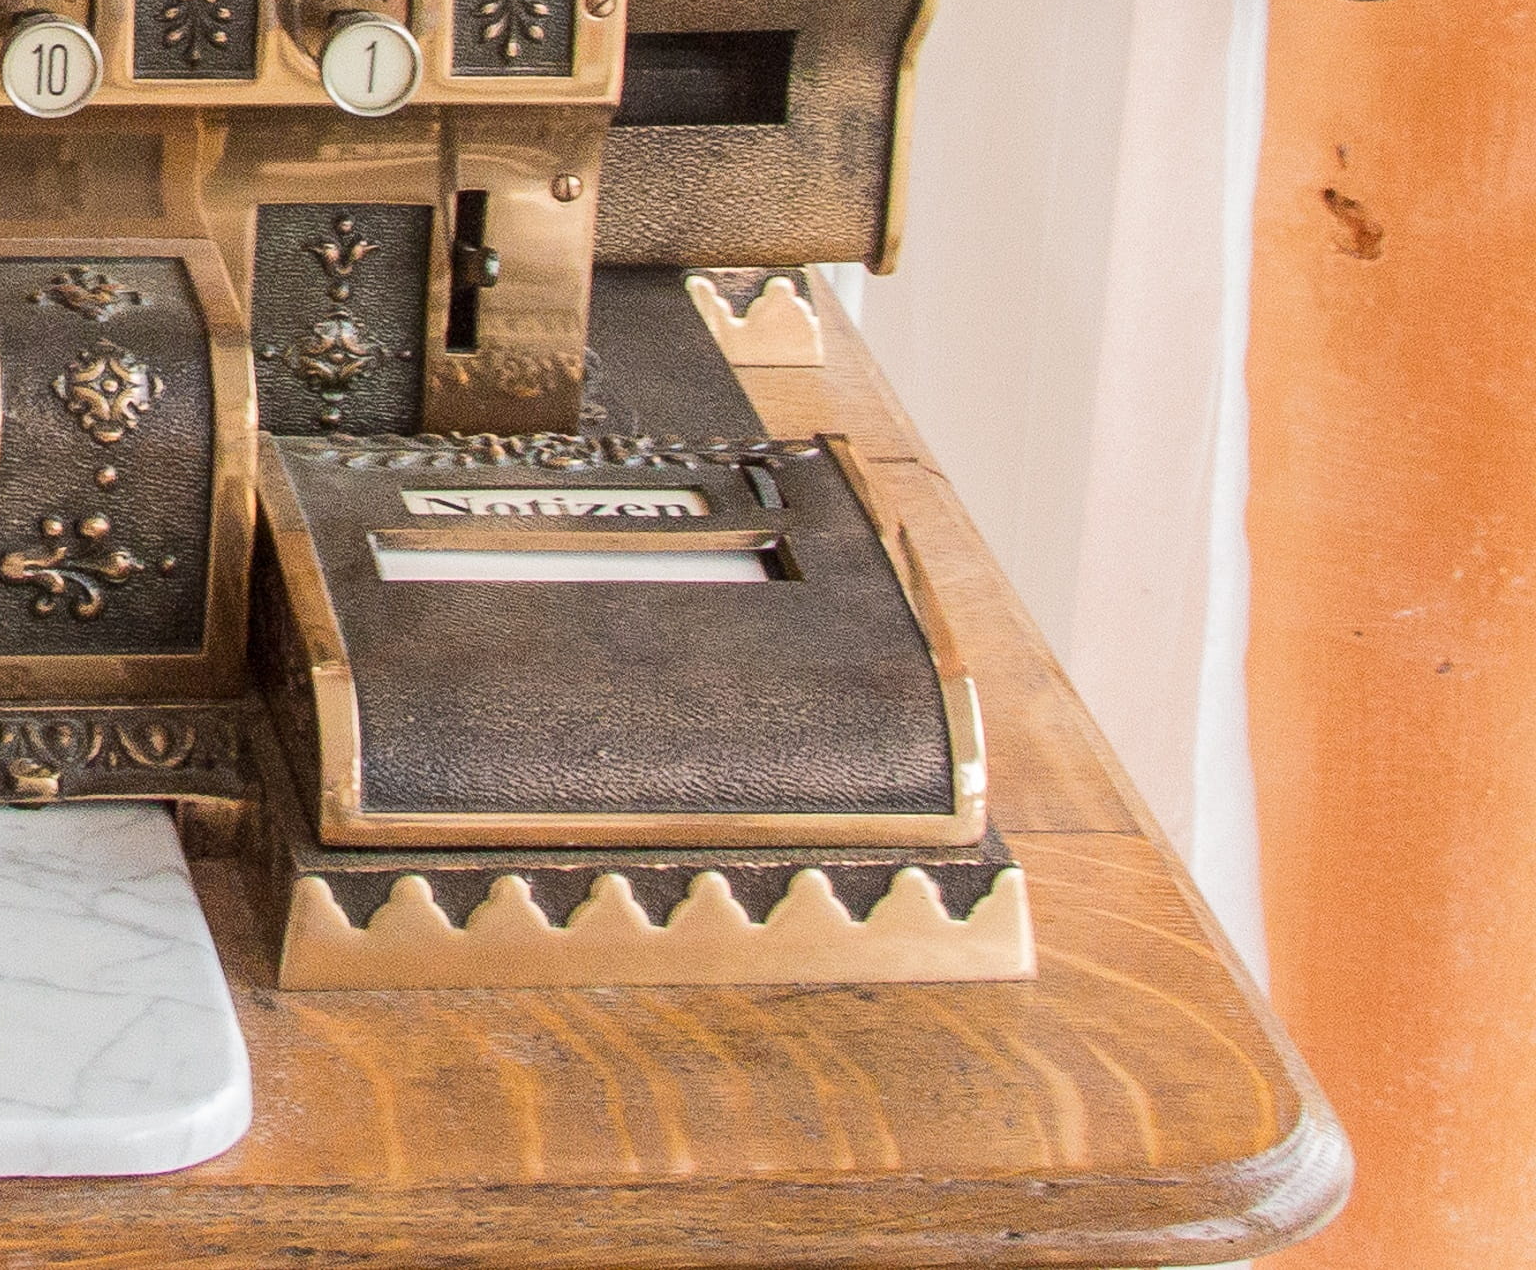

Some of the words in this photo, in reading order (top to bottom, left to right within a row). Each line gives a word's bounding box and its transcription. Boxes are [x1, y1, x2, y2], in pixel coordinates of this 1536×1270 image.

[32, 43, 68, 96] 10
[364, 41, 378, 94] 1
[424, 496, 694, 517] Notizen
